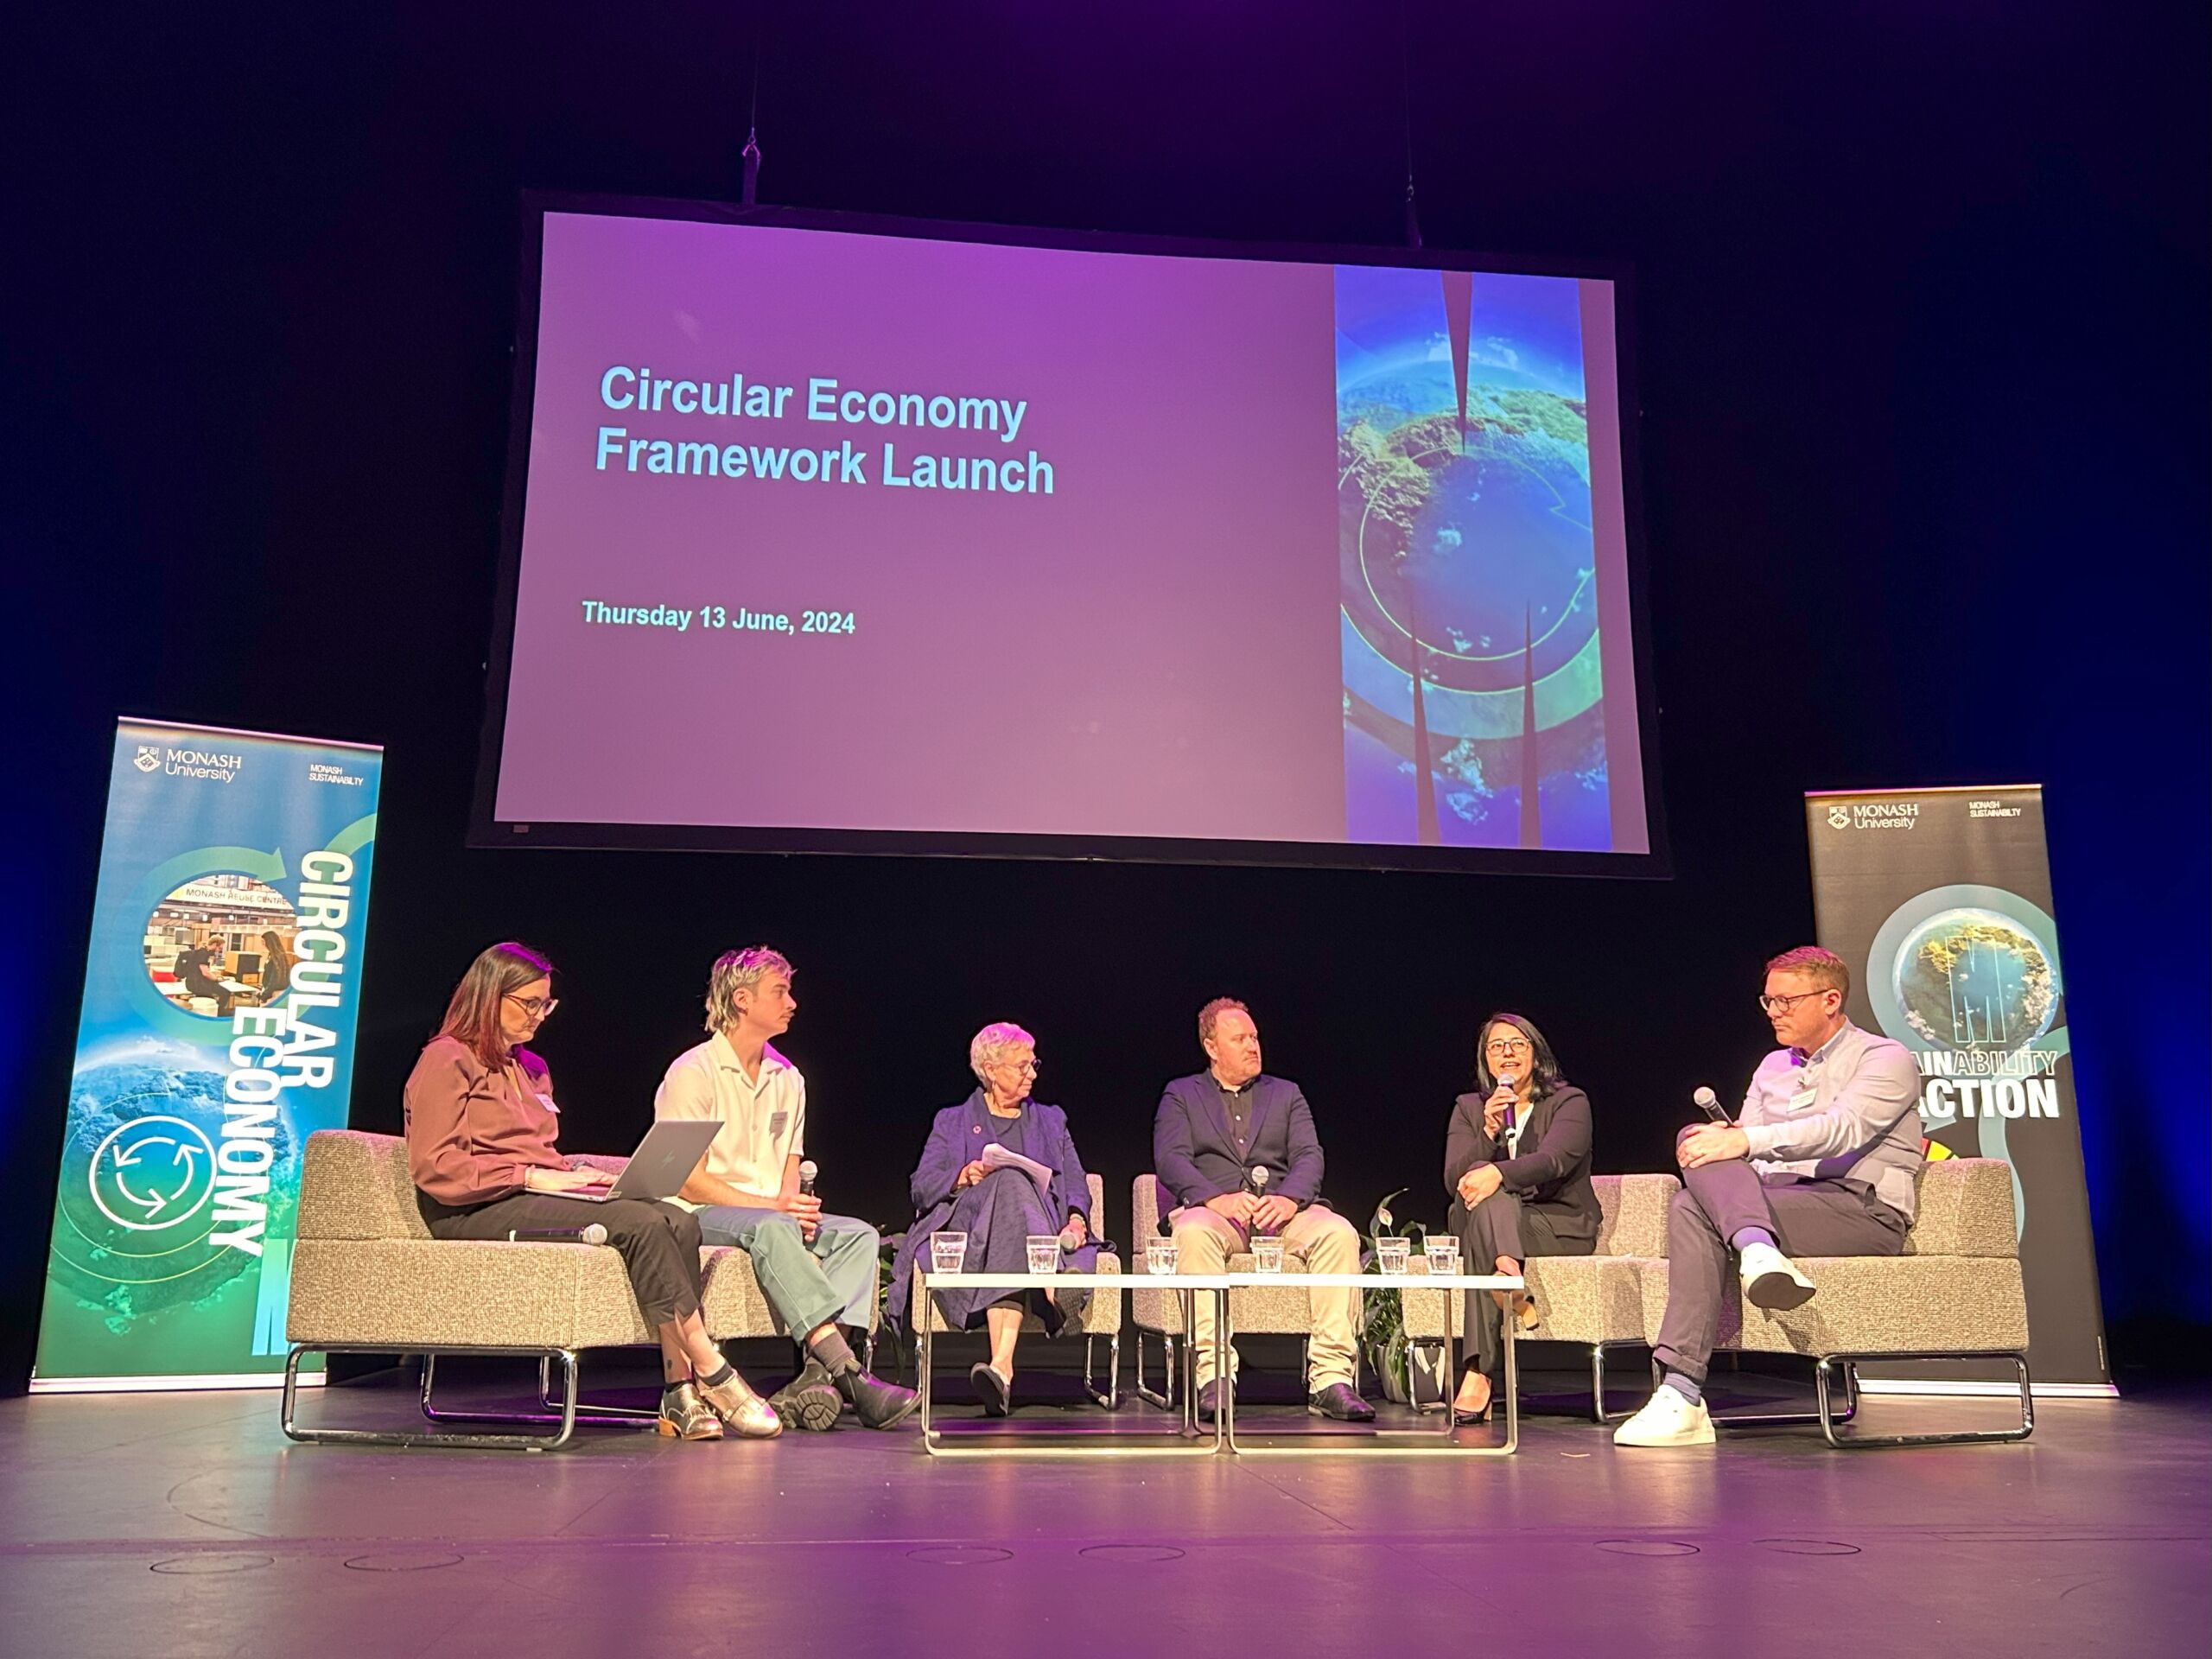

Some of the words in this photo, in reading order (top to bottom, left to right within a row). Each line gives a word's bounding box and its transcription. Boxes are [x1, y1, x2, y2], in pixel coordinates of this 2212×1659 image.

[601, 365, 793, 419] Circular
[807, 378, 1027, 443] Economy
[596, 427, 867, 484] Framework
[882, 442, 1054, 493] Launch
[582, 601, 692, 632] Thursday
[699, 607, 726, 628] 13
[732, 608, 795, 635] June,
[801, 611, 855, 634] 2024
[167, 748, 242, 769] MONASH
[165, 762, 235, 784] University
[310, 764, 343, 775] MONASH
[1853, 803, 1919, 817] MONASH
[1969, 800, 2000, 810] MONASH
[1854, 817, 1916, 830] University
[186, 888, 226, 899] MONASH
[281, 850, 353, 1089] CIRCULAR
[208, 1007, 288, 1257] ECONOMY
